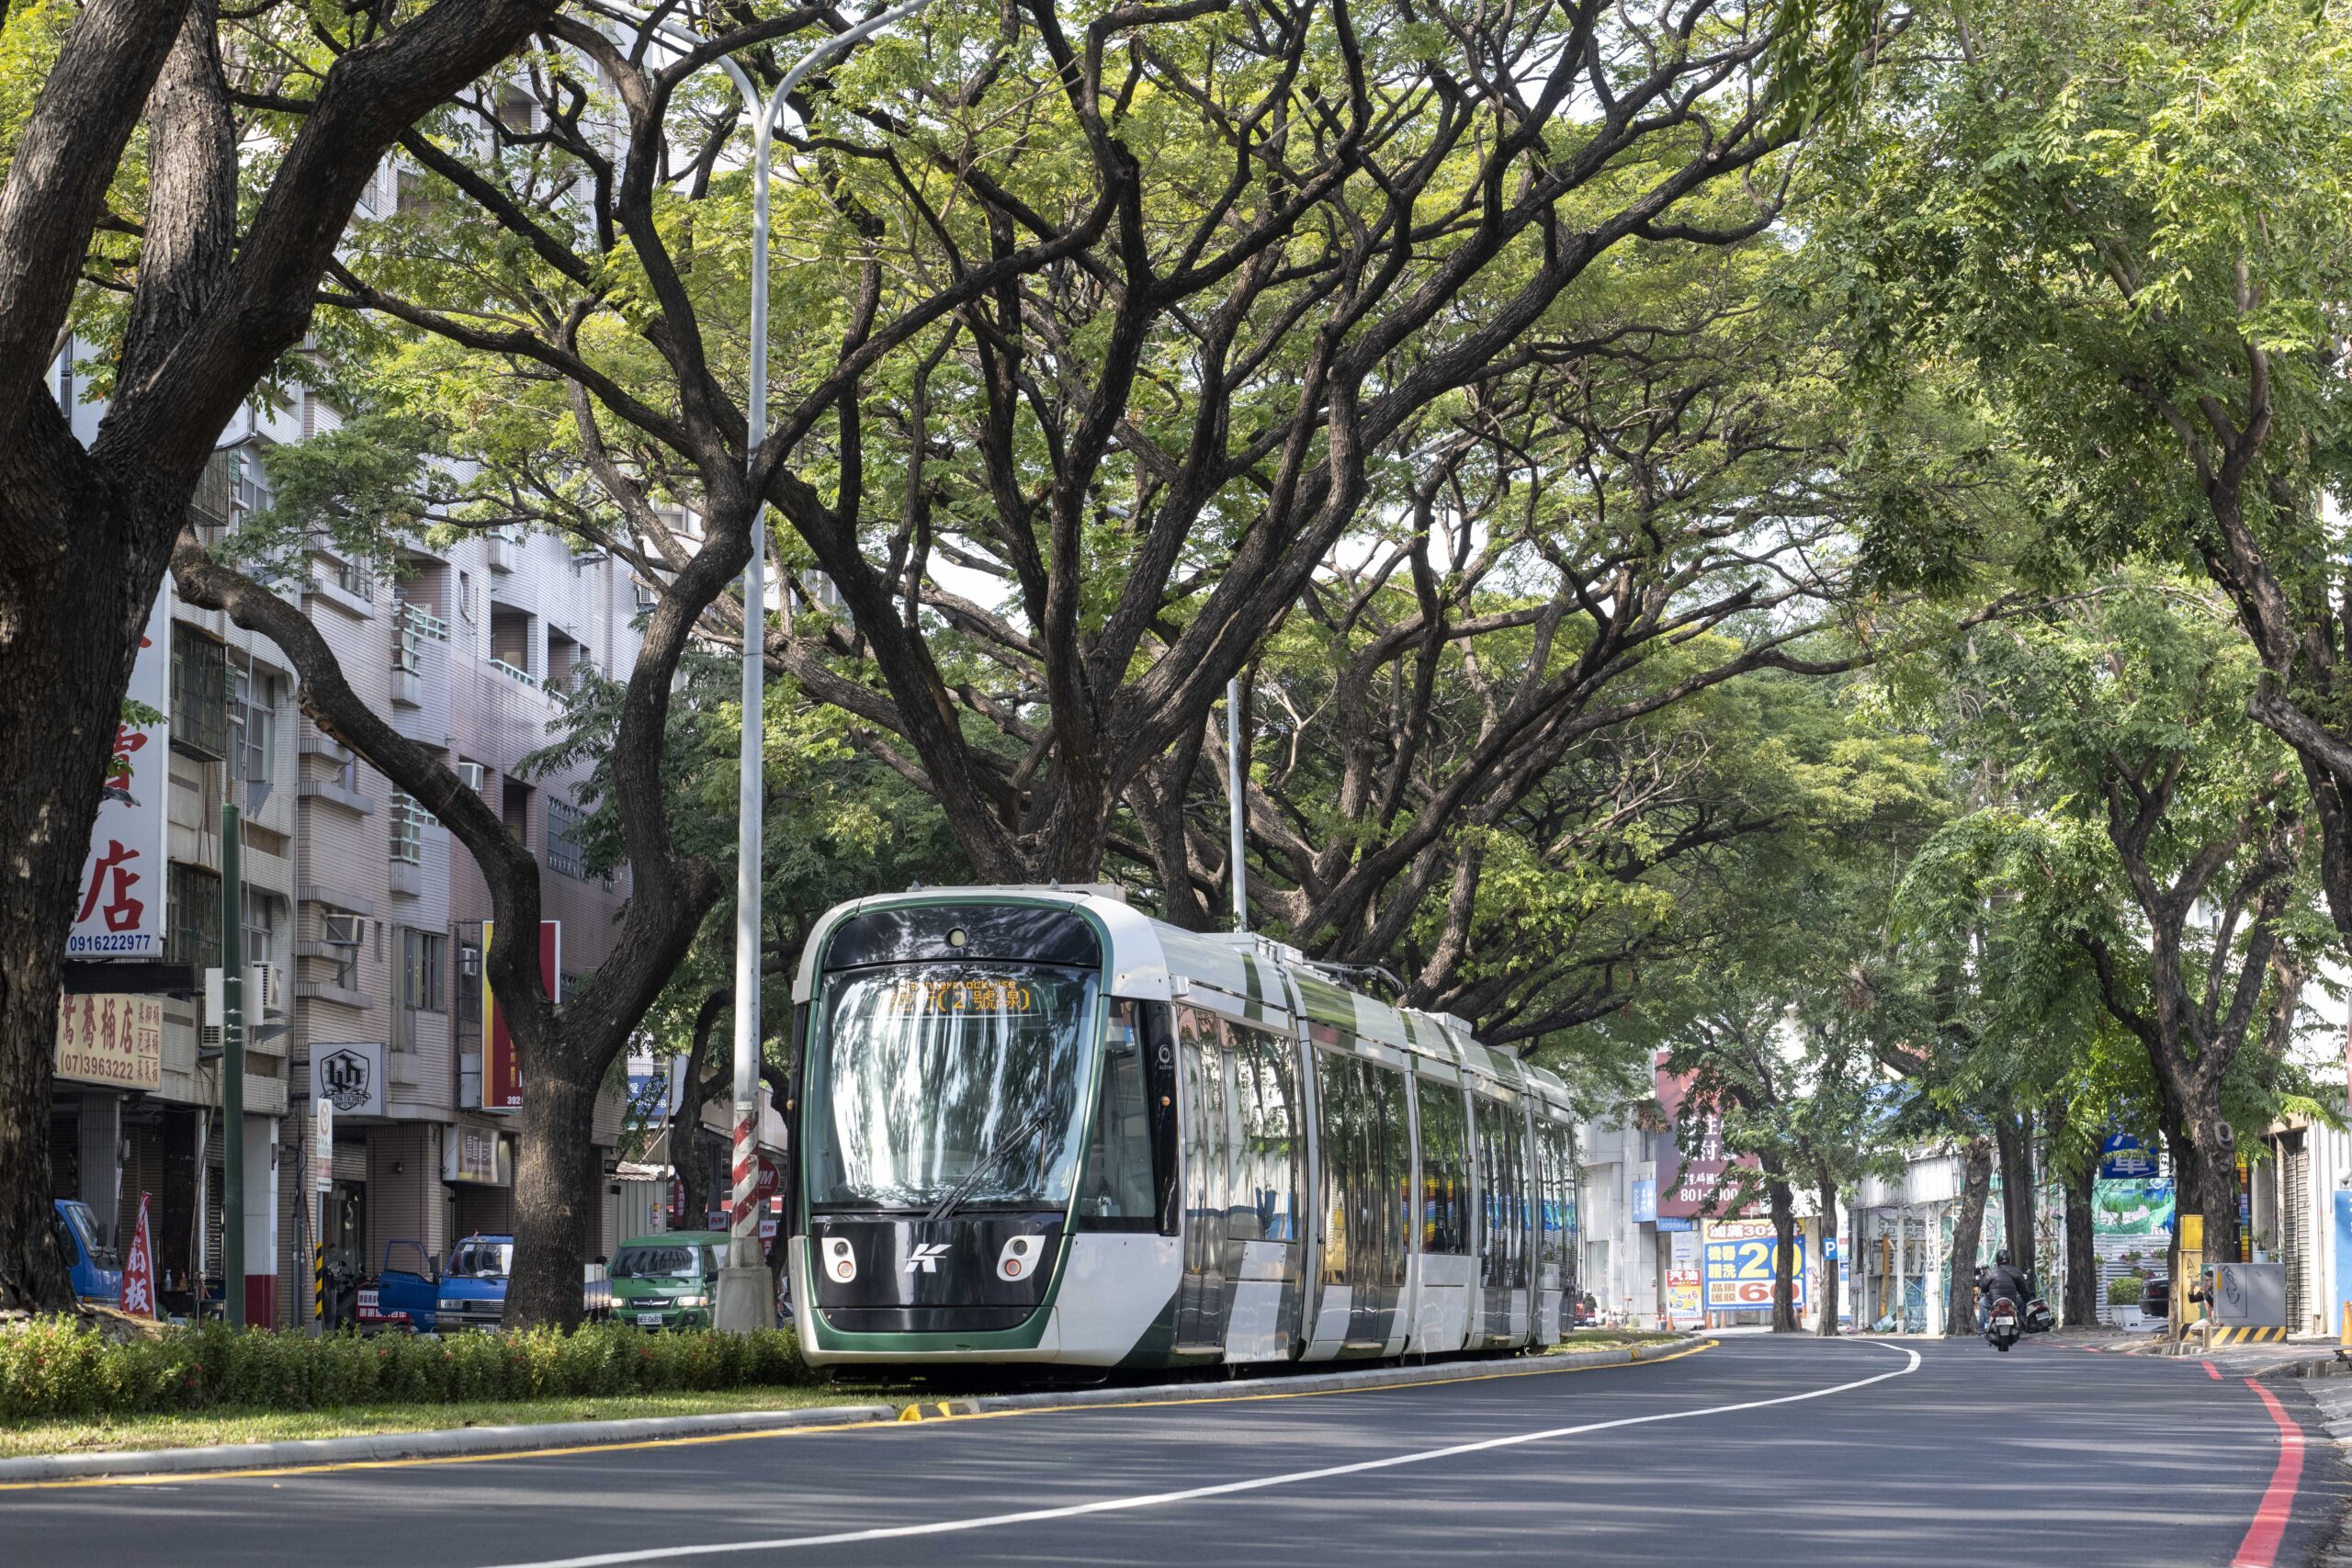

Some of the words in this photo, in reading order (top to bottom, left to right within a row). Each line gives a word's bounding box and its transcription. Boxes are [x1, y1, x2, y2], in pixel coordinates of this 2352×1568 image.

[70, 935, 151, 952] 0916222977
[62, 1051, 133, 1081] (07)3963222
[506, 1096, 523, 1105] 392
[1825, 1241, 1837, 1258] P
[1668, 1270, 1700, 1282] 汽油
